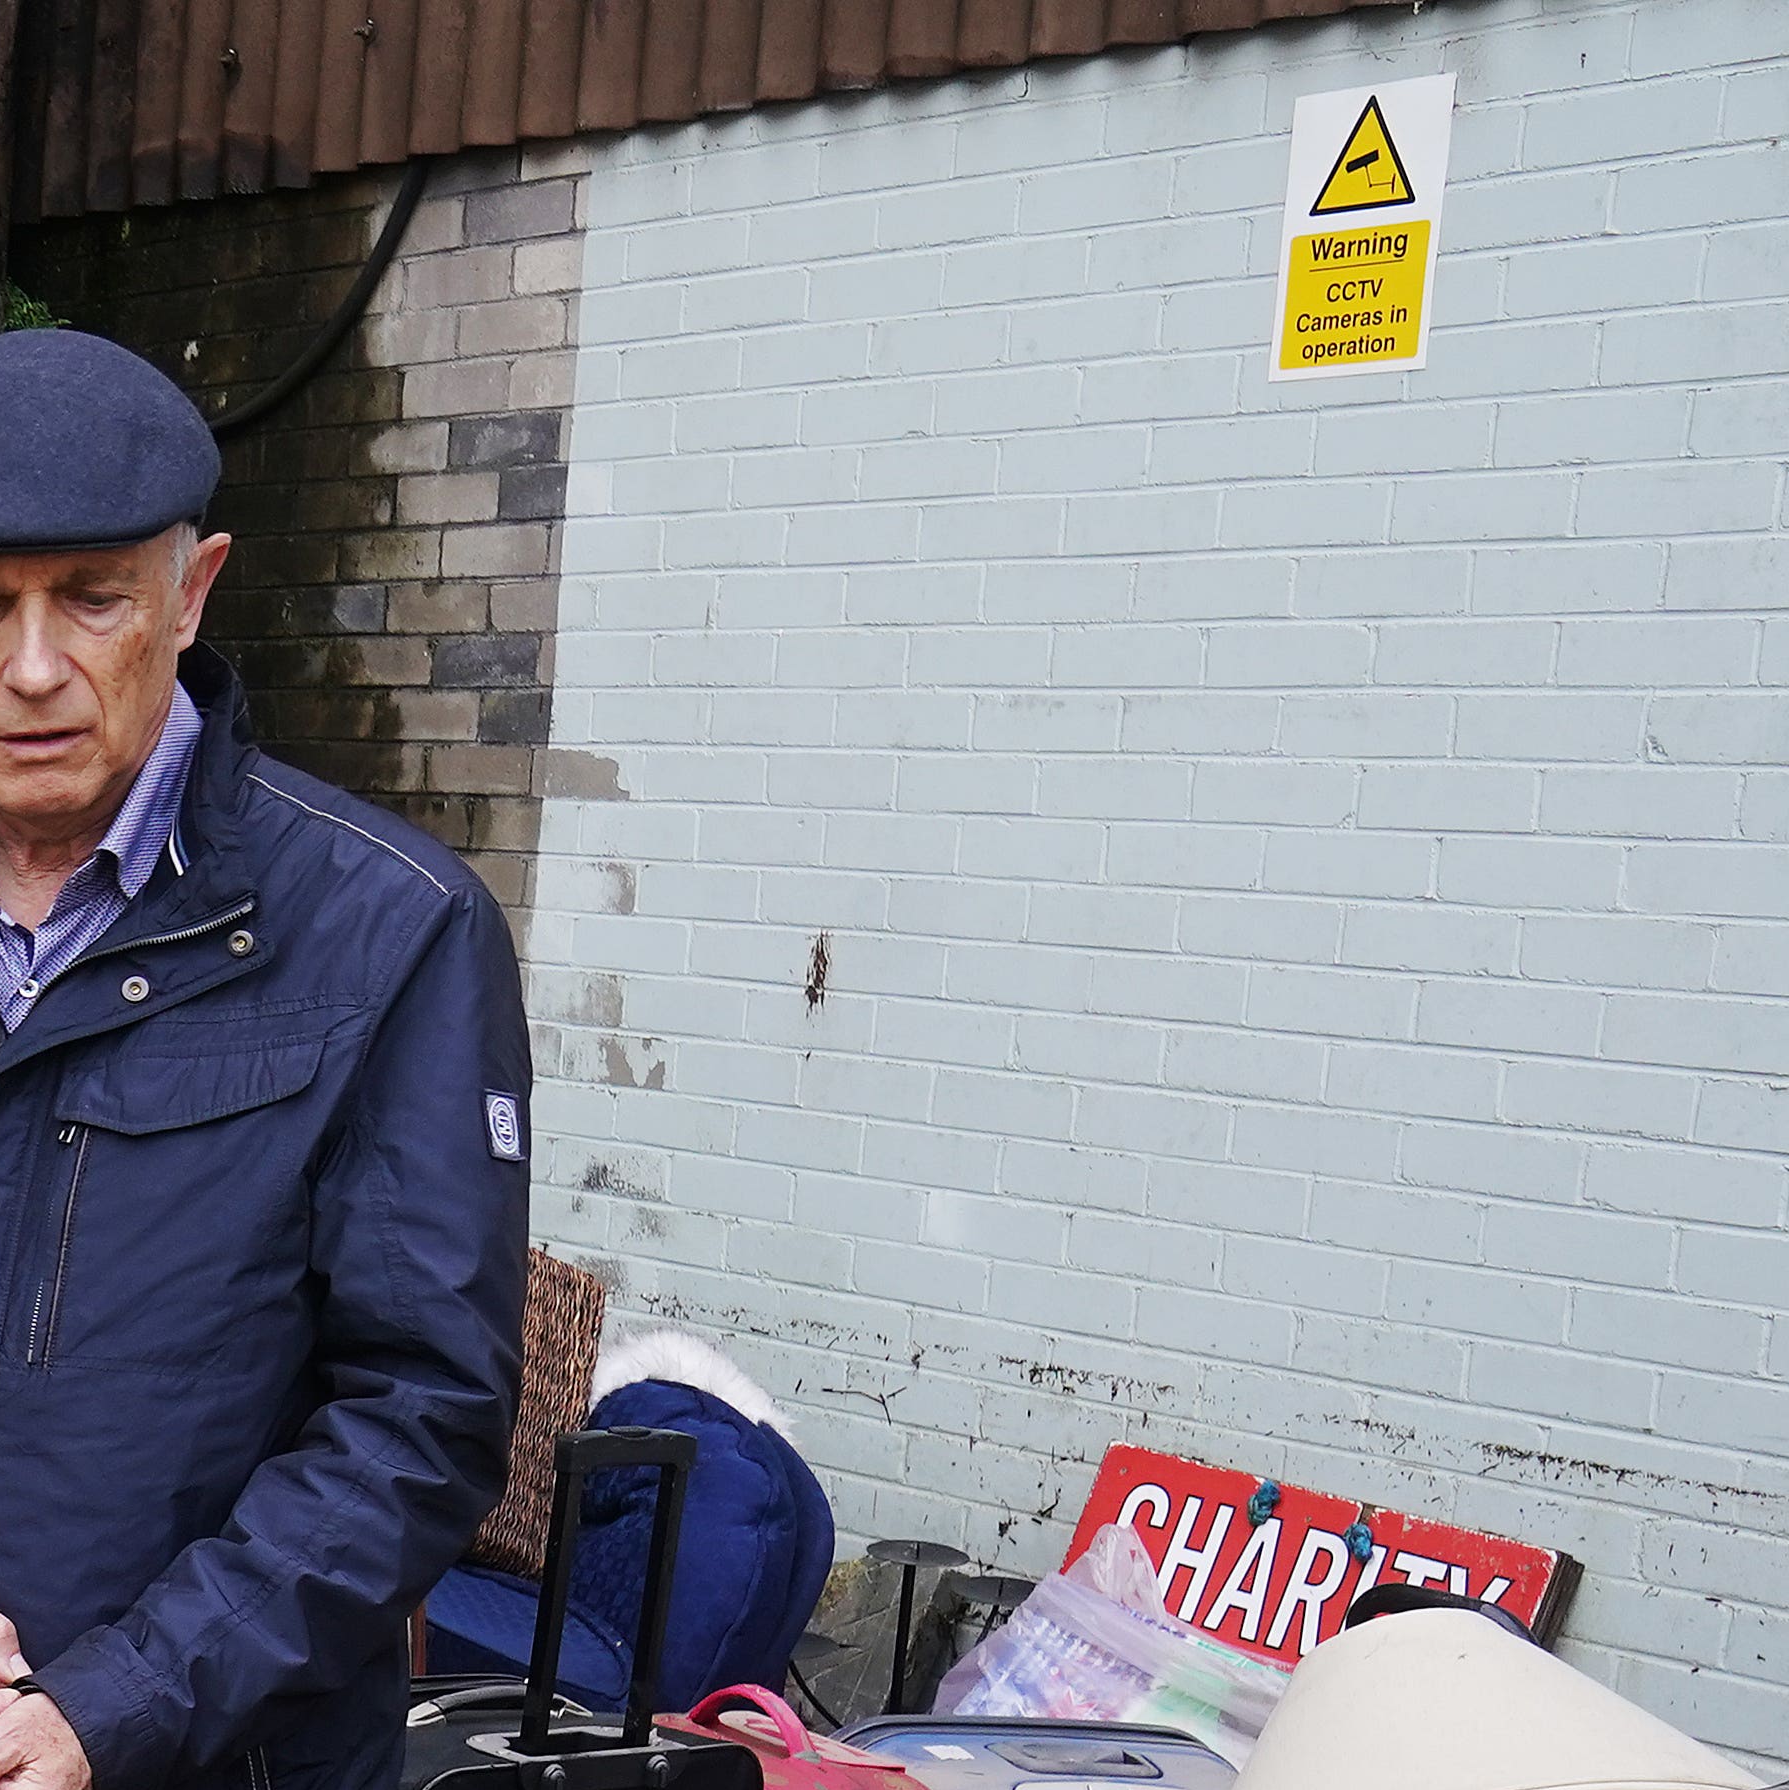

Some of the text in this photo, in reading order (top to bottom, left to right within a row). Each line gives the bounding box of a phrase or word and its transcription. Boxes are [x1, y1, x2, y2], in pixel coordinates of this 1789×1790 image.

[1311, 232, 1408, 261] Warning
[1326, 278, 1383, 302] CCTV
[1296, 305, 1408, 333] Cameras in
[1302, 334, 1396, 363] operation
